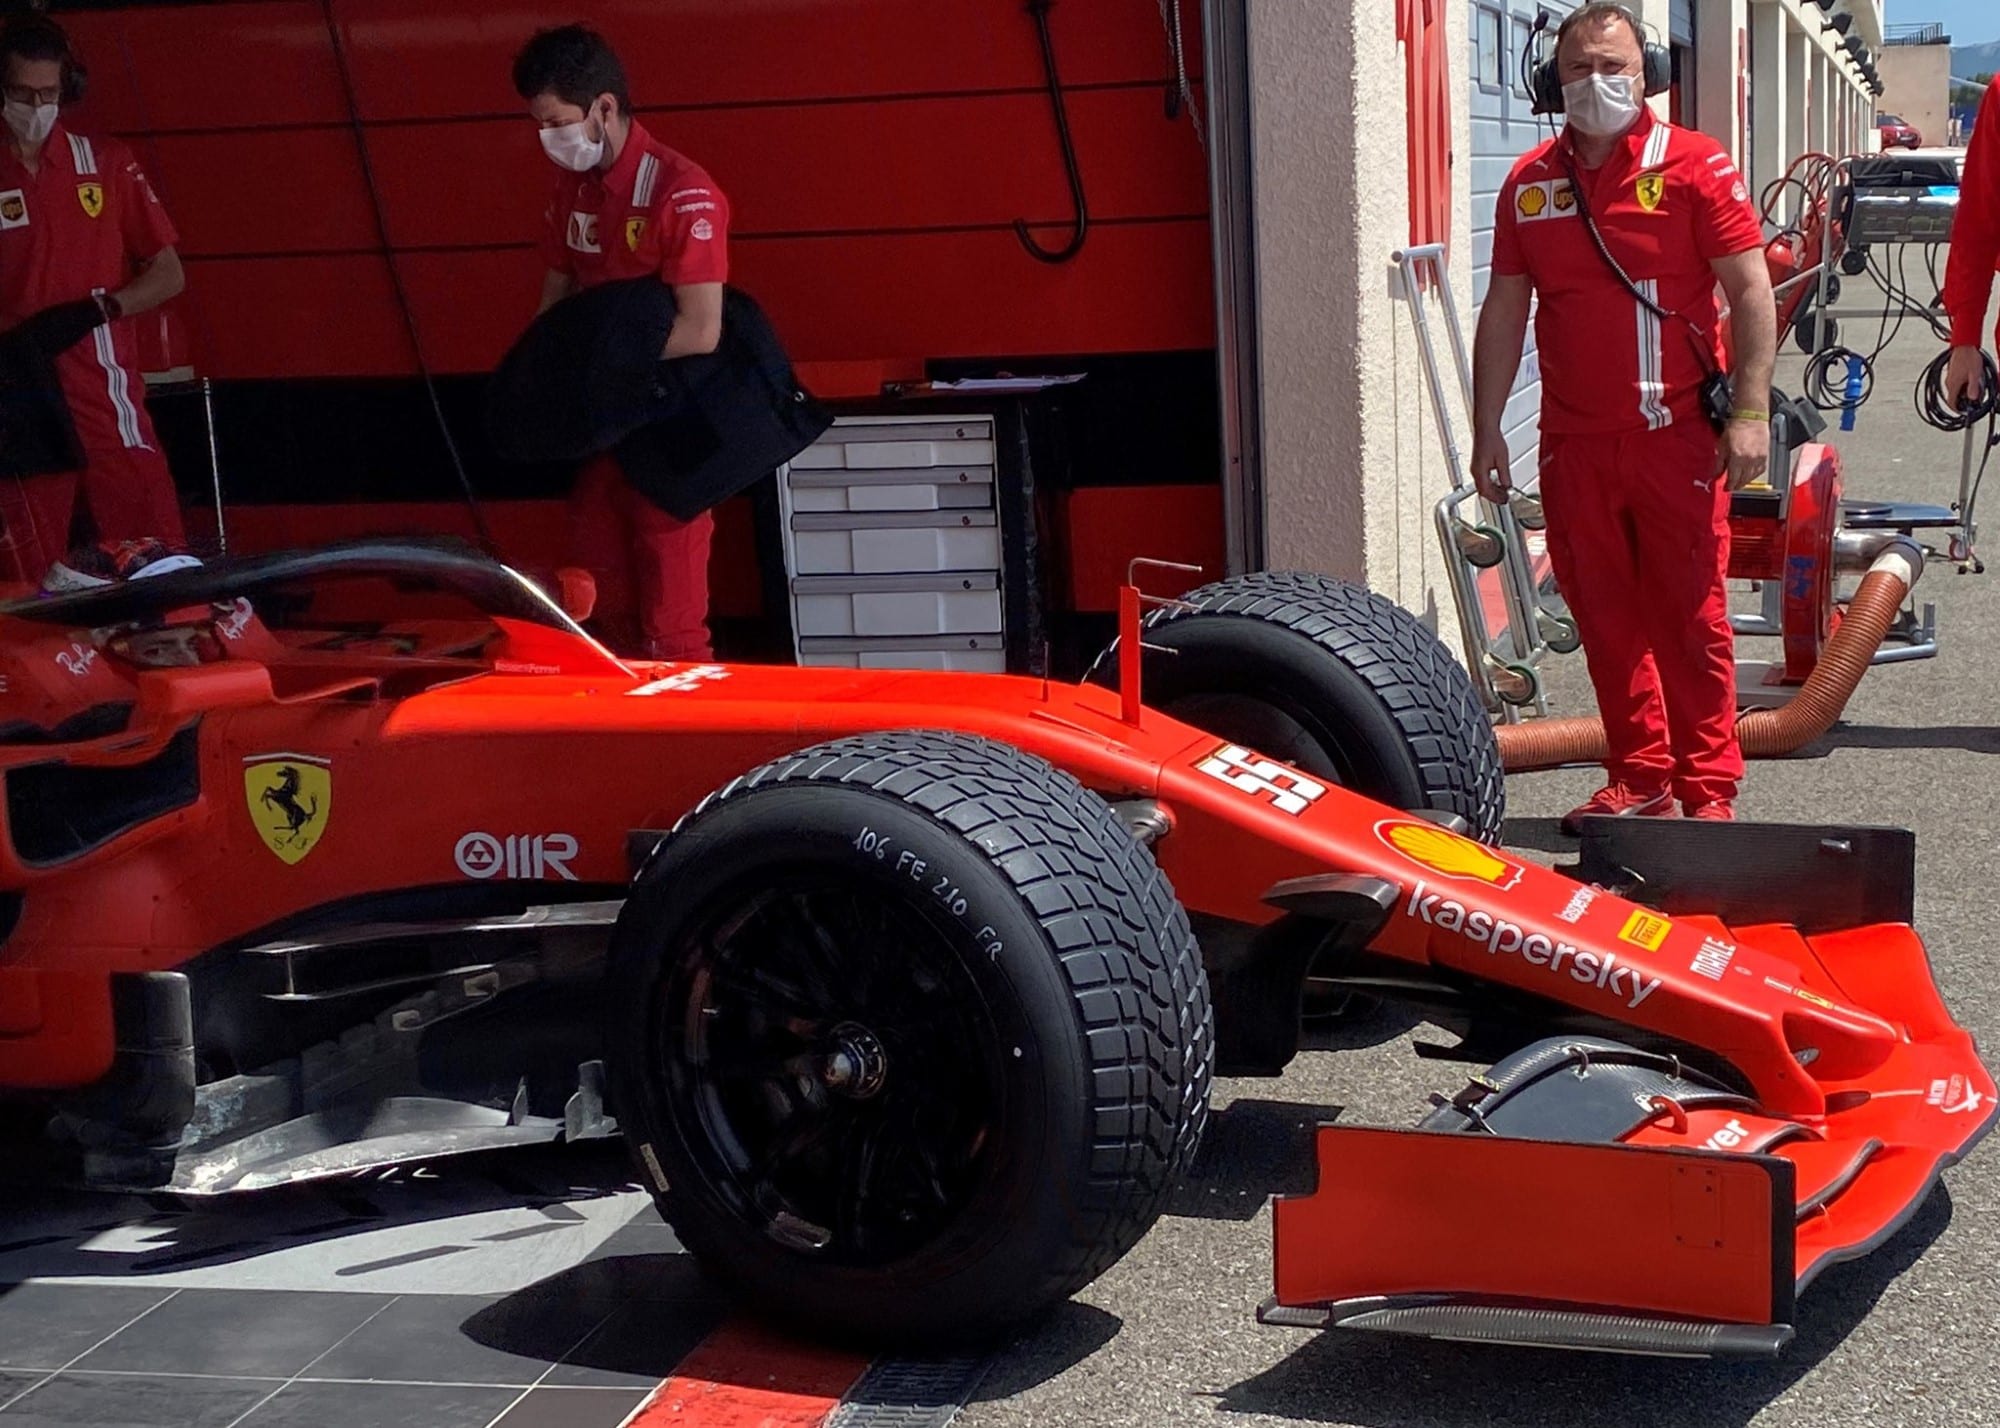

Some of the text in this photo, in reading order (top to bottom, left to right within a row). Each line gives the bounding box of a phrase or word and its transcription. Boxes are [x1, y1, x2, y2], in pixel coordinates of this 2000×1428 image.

[1192, 742, 1329, 816] 55
[853, 826, 1004, 962] 106 FE 210 FR
[1406, 879, 1663, 1010] kaspersky
[1688, 935, 1738, 982] MAHLE
